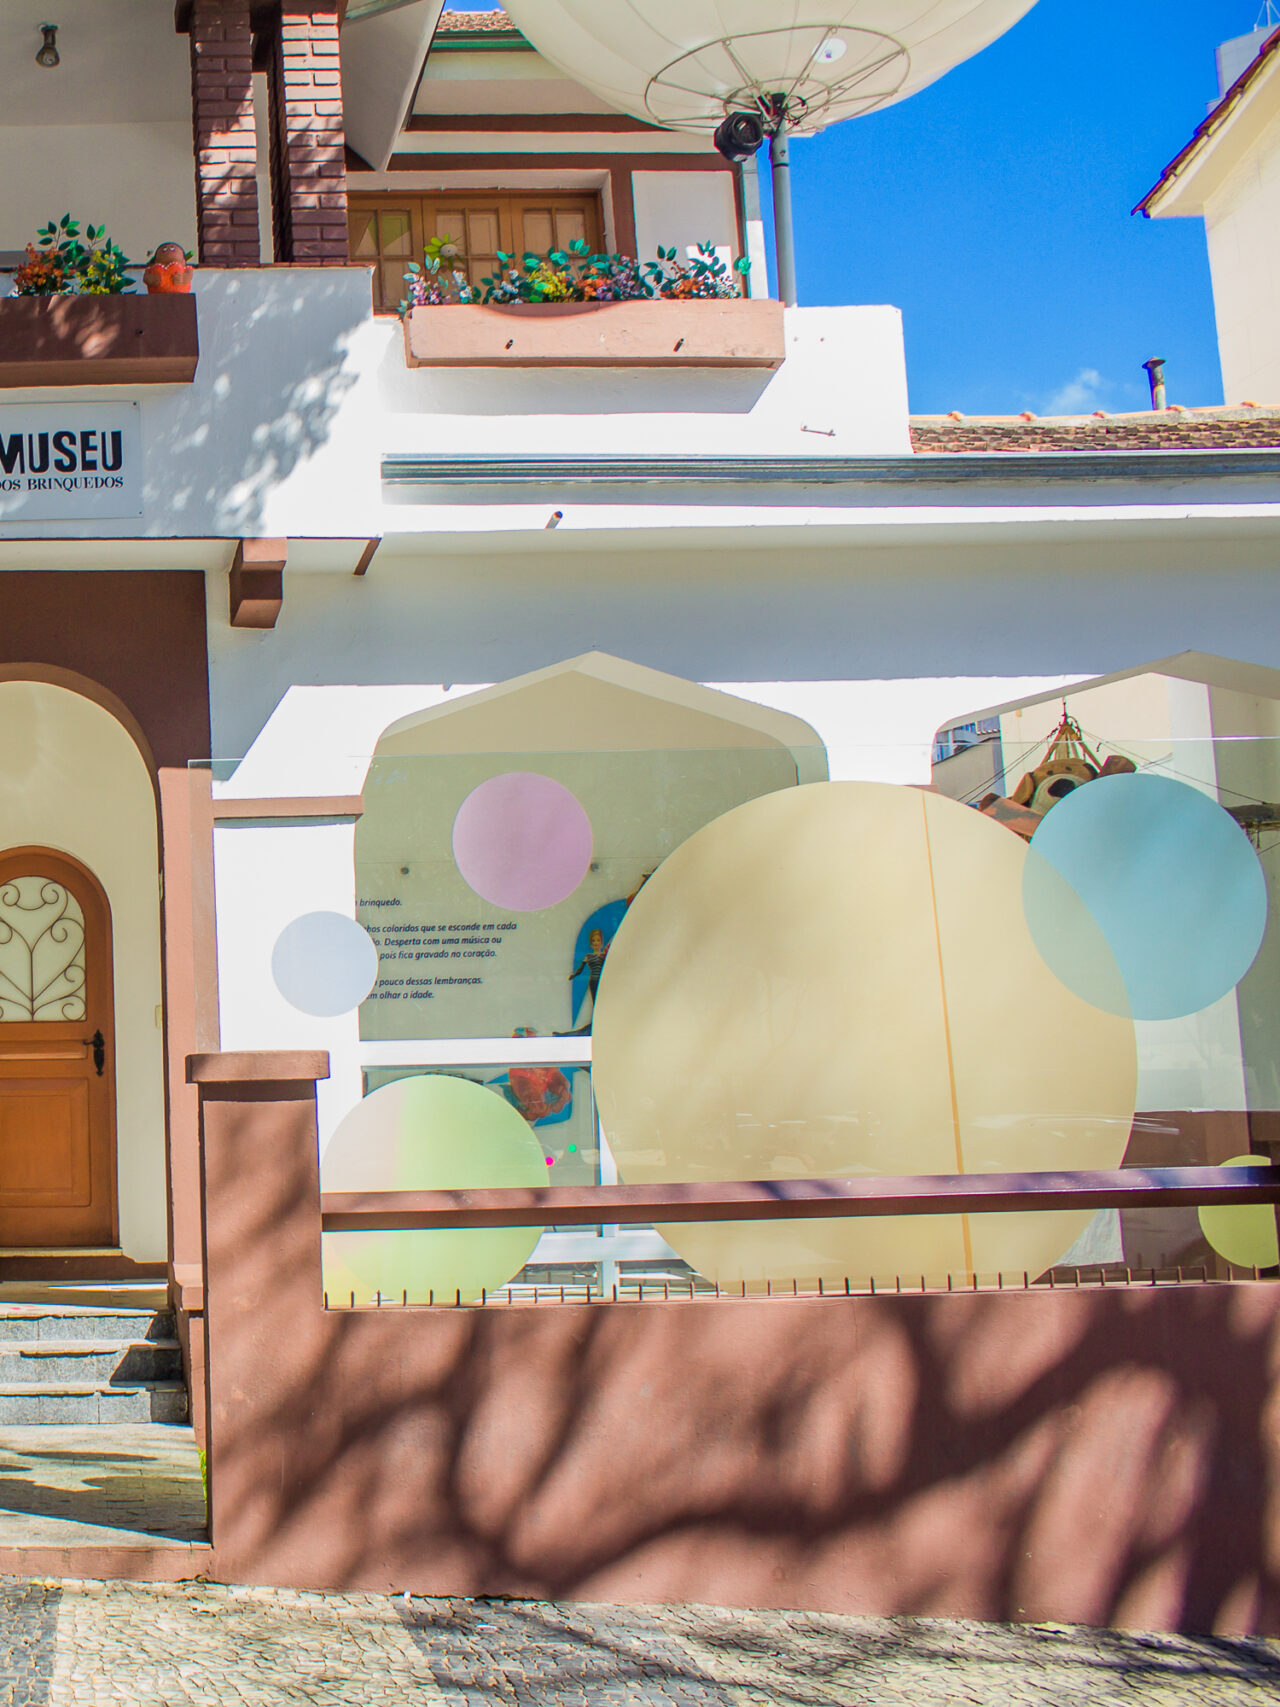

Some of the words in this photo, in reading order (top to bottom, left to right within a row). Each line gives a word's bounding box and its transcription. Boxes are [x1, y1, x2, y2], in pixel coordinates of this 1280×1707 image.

[27, 476, 124, 493] BRINQUEDOS
[360, 898, 402, 909] brinquedo.
[382, 922, 419, 934] coloridos
[420, 924, 436, 935] que
[437, 924, 447, 933] se
[448, 921, 481, 932] esconde
[482, 923, 495, 931] em
[496, 921, 517, 930] cada
[383, 937, 422, 948] Desperta
[422, 937, 440, 945] com
[441, 937, 460, 945] uma
[461, 935, 490, 944] música
[490, 936, 503, 944] ou
[379, 950, 397, 961] pois
[397, 949, 414, 959] fica
[415, 949, 449, 961] gravado
[450, 951, 462, 959] no
[462, 948, 497, 959] coração.
[378, 978, 404, 988] pouco
[405, 976, 433, 986] dessas
[434, 976, 483, 986] lembranças.
[379, 990, 402, 1000] olhar
[409, 990, 435, 1000] idade.
